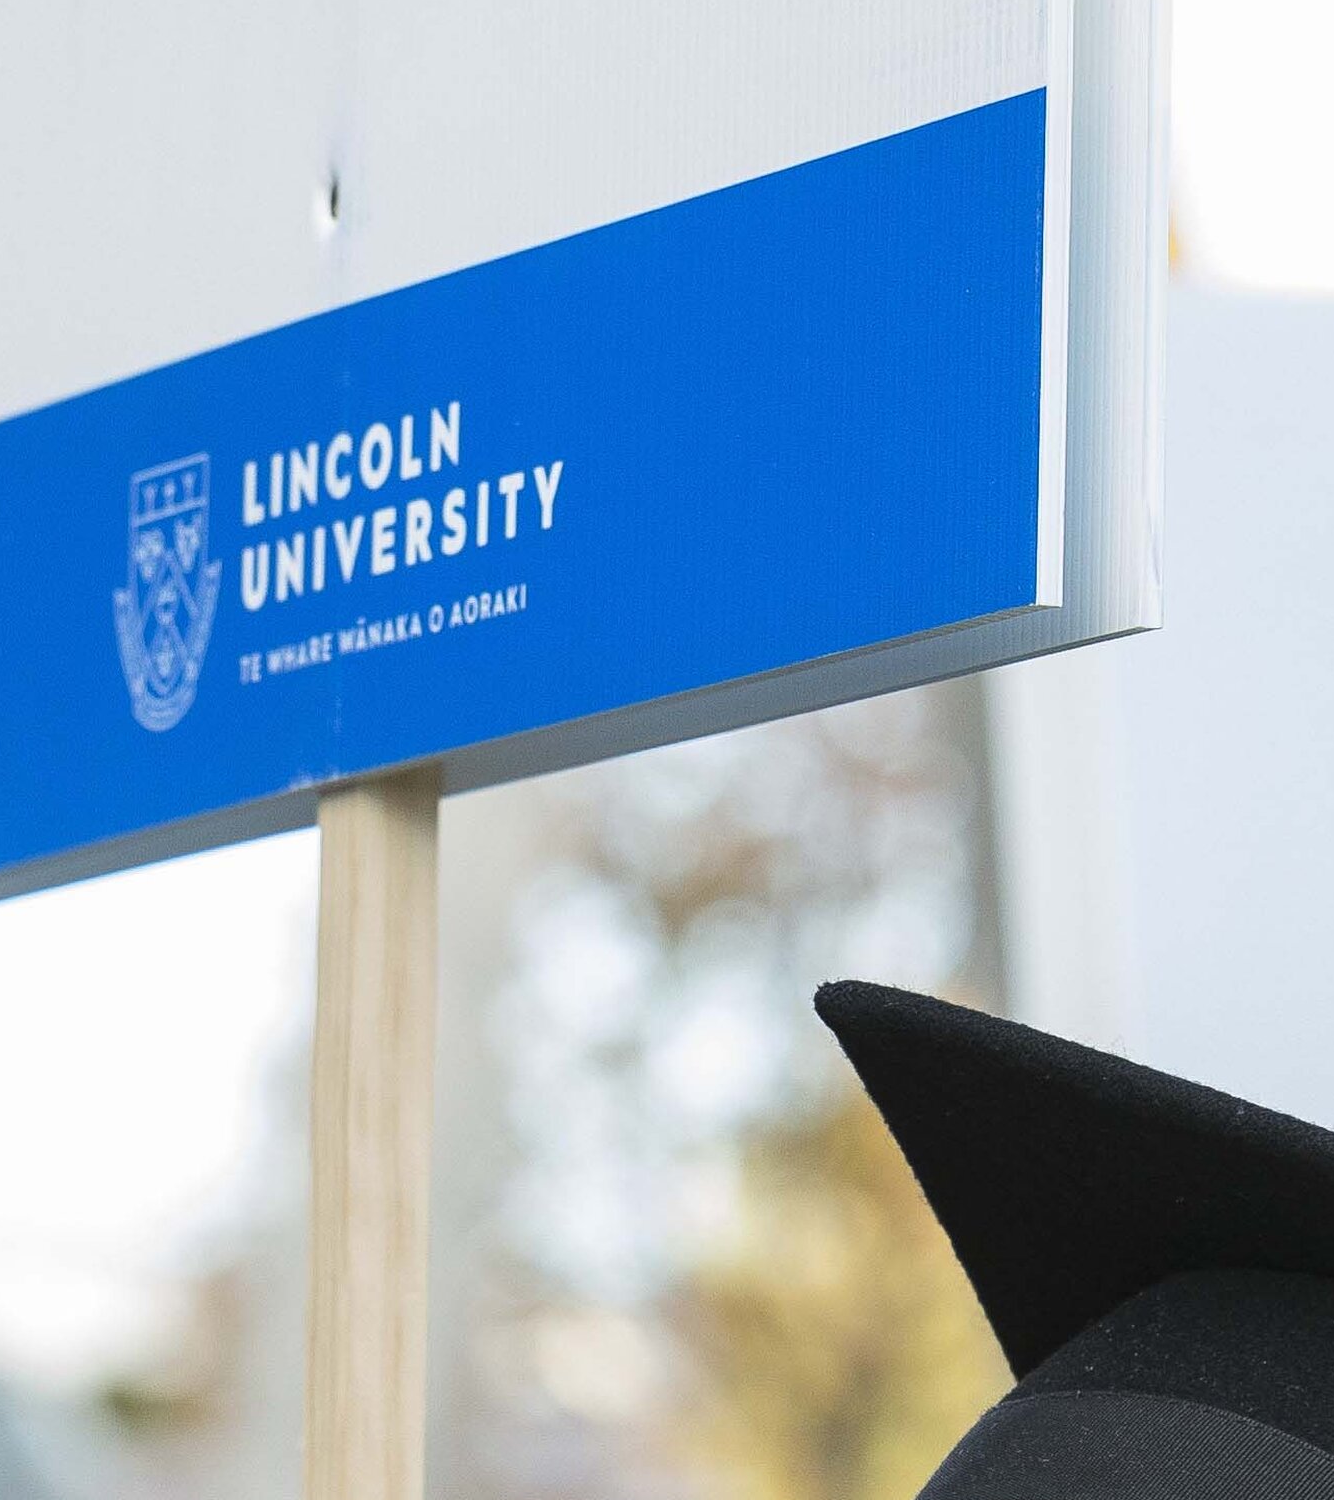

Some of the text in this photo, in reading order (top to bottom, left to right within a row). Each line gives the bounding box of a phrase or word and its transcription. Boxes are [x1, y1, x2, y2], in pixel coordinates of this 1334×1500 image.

[243, 401, 460, 527] LINCOLN
[241, 460, 564, 612] UNIVERSITY
[239, 653, 262, 685] TE
[267, 632, 334, 675] WHARE
[428, 604, 444, 633] O
[449, 583, 526, 628] AORAKI
